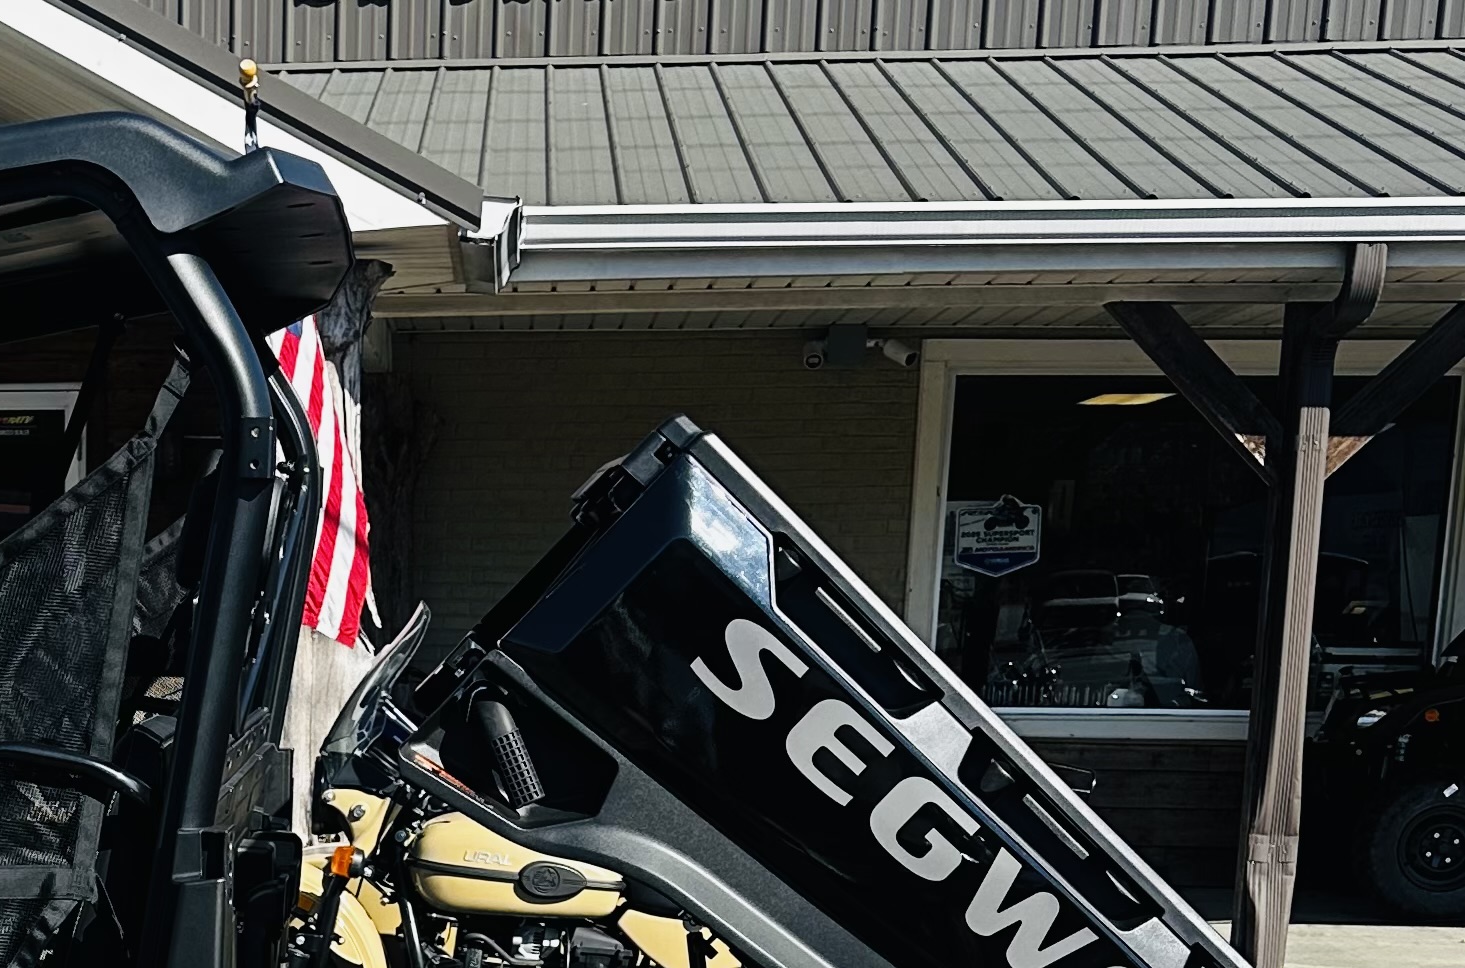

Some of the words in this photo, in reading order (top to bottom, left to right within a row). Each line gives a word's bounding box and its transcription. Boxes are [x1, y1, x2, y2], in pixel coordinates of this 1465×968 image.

[983, 529, 1035, 537] SUPERSPORT
[976, 536, 1020, 544] CHAMPION
[463, 849, 512, 866] URAL
